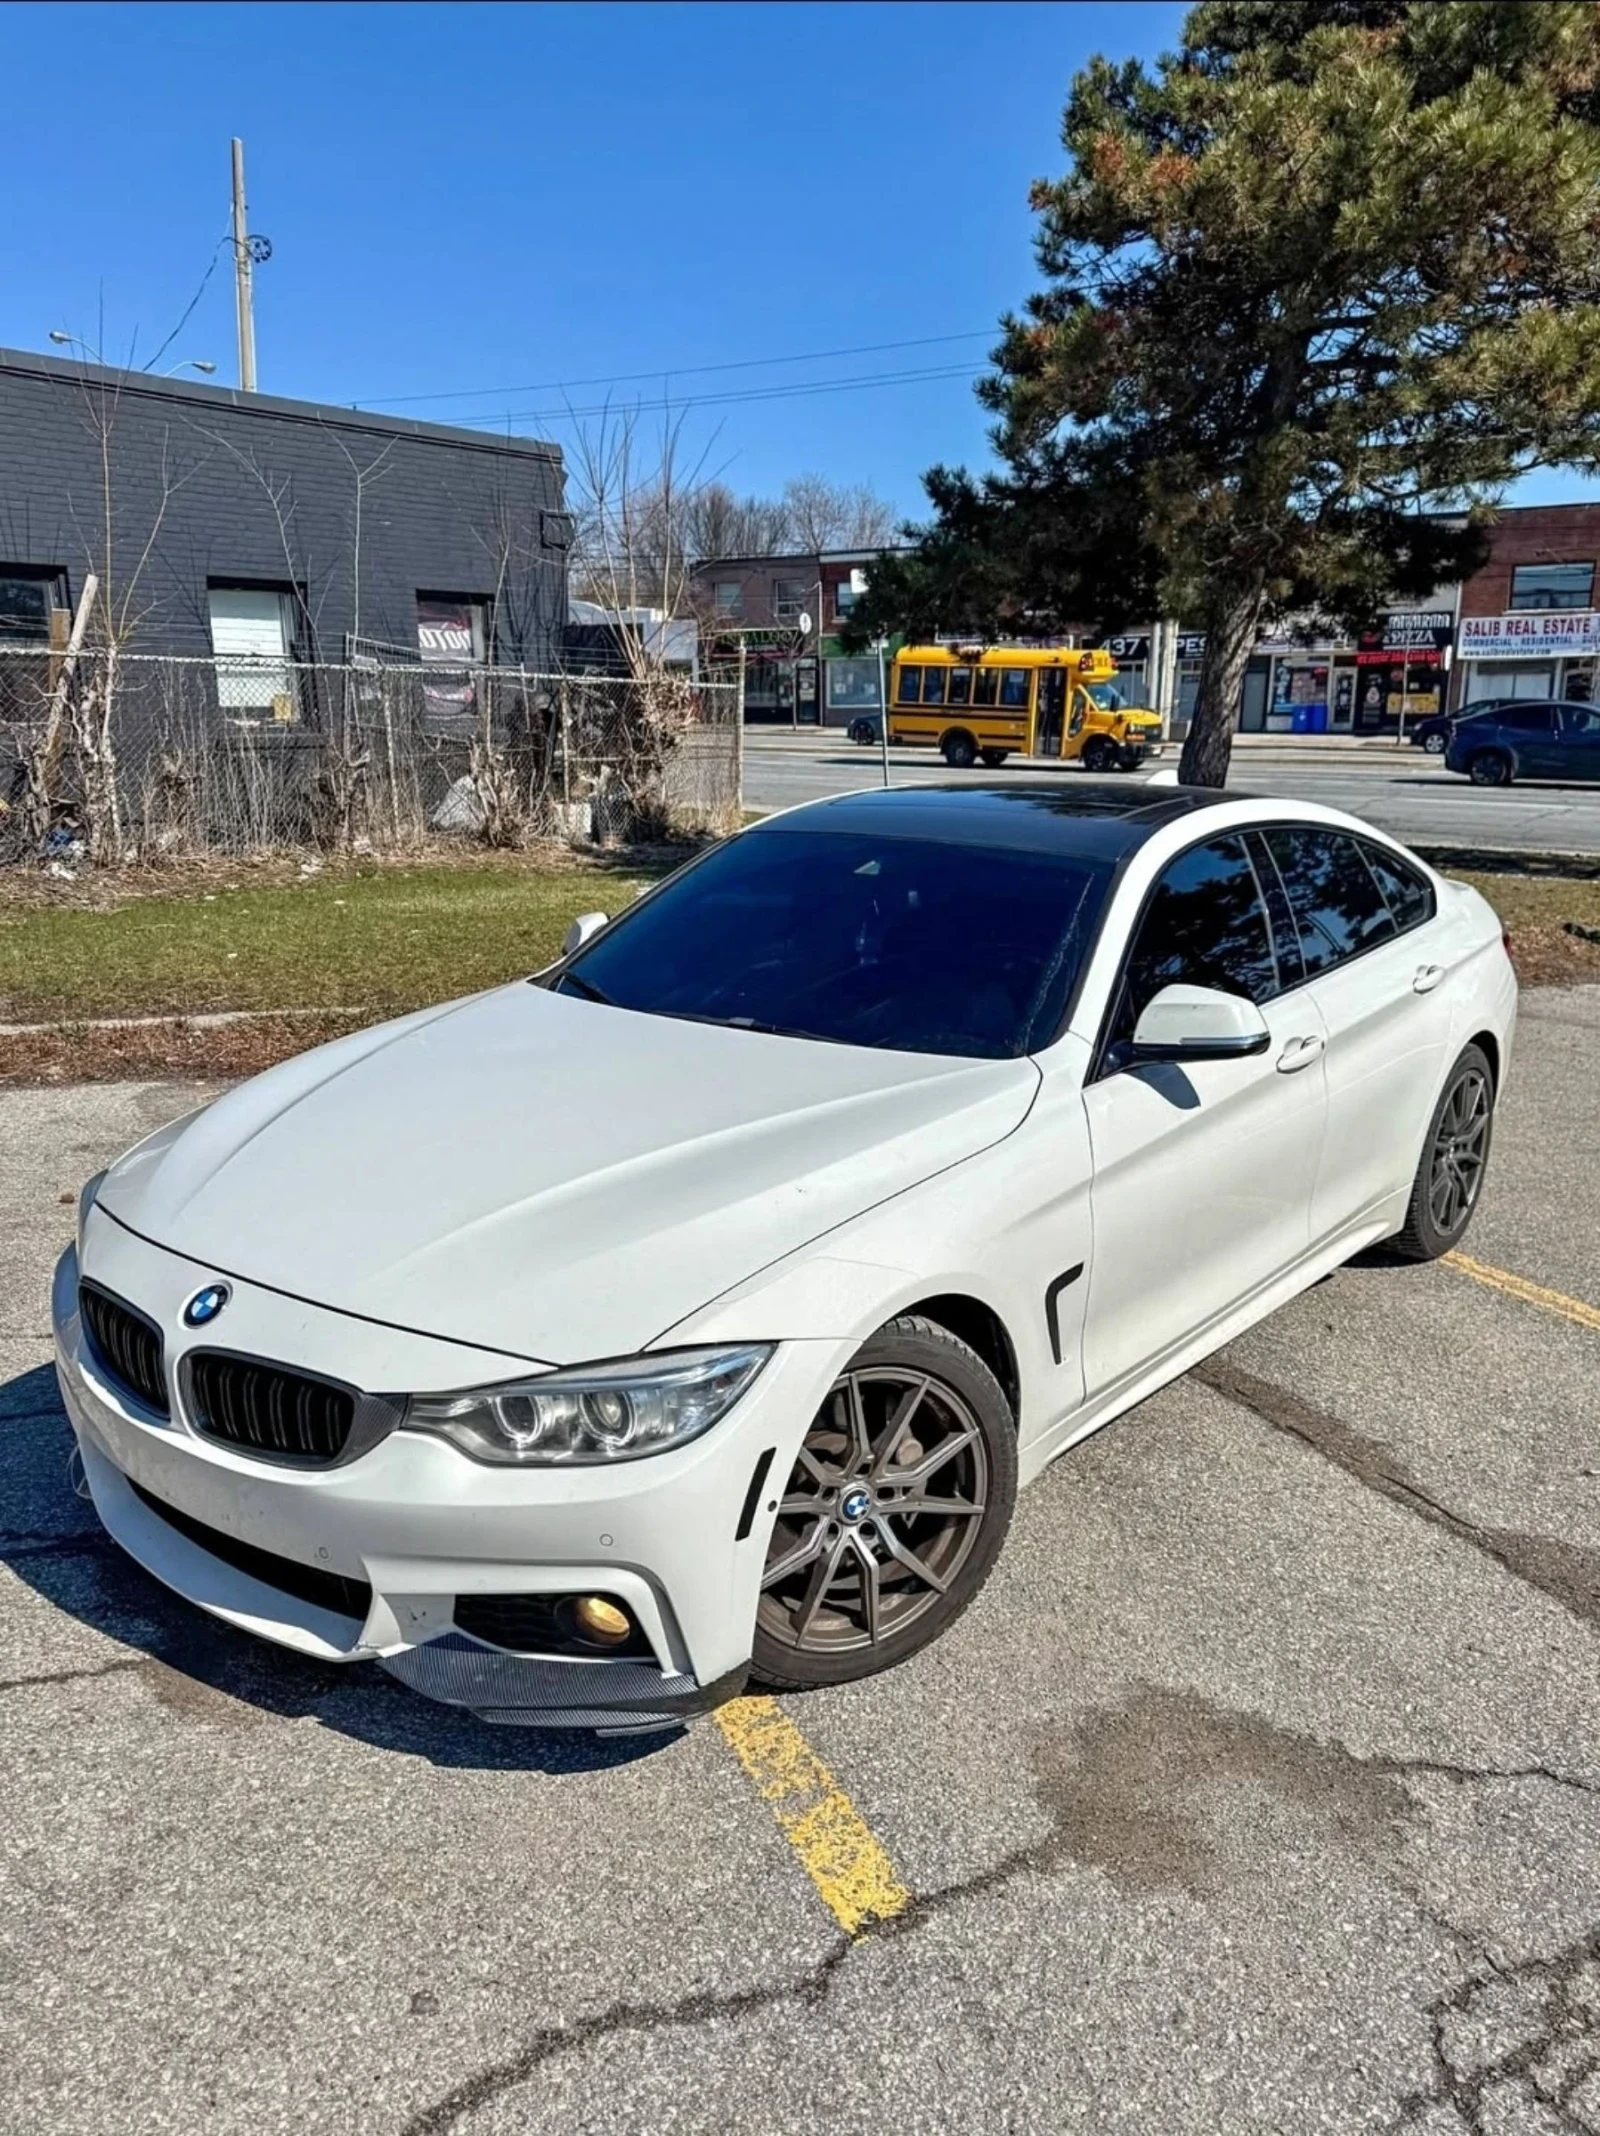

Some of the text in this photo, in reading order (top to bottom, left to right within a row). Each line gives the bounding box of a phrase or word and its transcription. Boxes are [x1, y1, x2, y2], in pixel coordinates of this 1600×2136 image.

[1465, 617, 1591, 637] SALIB REAL ESTATE
[1391, 630, 1435, 643] PIZZA
[1462, 637, 1513, 647] COMMERCIAL
[1520, 635, 1573, 646] RESIDENTIAL
[1099, 638, 1140, 656] 437
